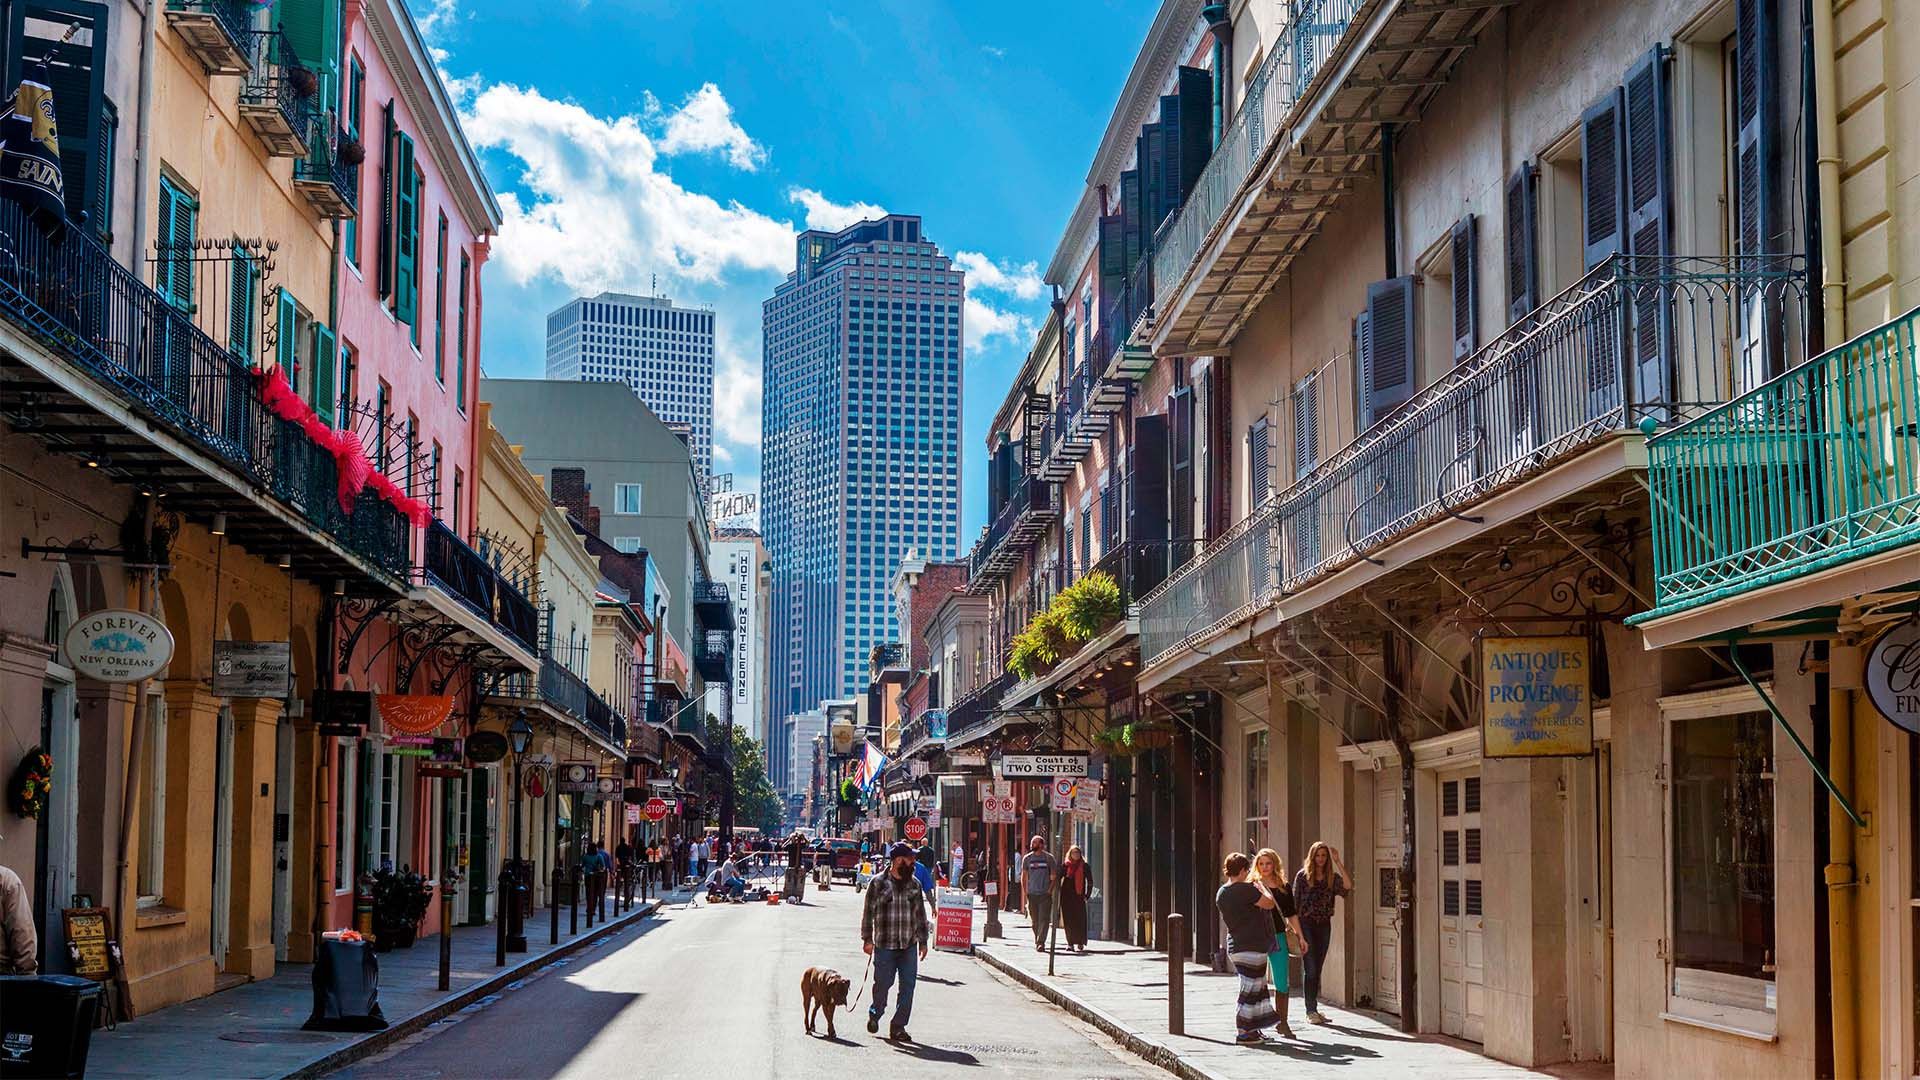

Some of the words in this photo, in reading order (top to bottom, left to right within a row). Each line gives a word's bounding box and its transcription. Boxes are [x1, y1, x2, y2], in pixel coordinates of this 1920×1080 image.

[740, 556, 748, 601] HOTEL
[81, 617, 157, 643] FOREVER
[738, 607, 748, 697] MONTELEONE
[80, 655, 103, 664] NEW
[107, 656, 154, 668] ORLEANS
[1489, 651, 1582, 671] ANTIQUES
[1526, 672, 1545, 682] DE
[1489, 684, 1585, 703] PROVENCE
[1489, 717, 1528, 728] FRENCH
[1035, 756, 1064, 764] Court
[1068, 756, 1079, 765] of
[1006, 764, 1032, 773] TWO
[1036, 764, 1084, 773] SISTERS
[646, 804, 666, 813] STOP
[905, 824, 925, 833] STOP
[938, 910, 971, 918] PASSENGER
[937, 935, 969, 944] PARKING
